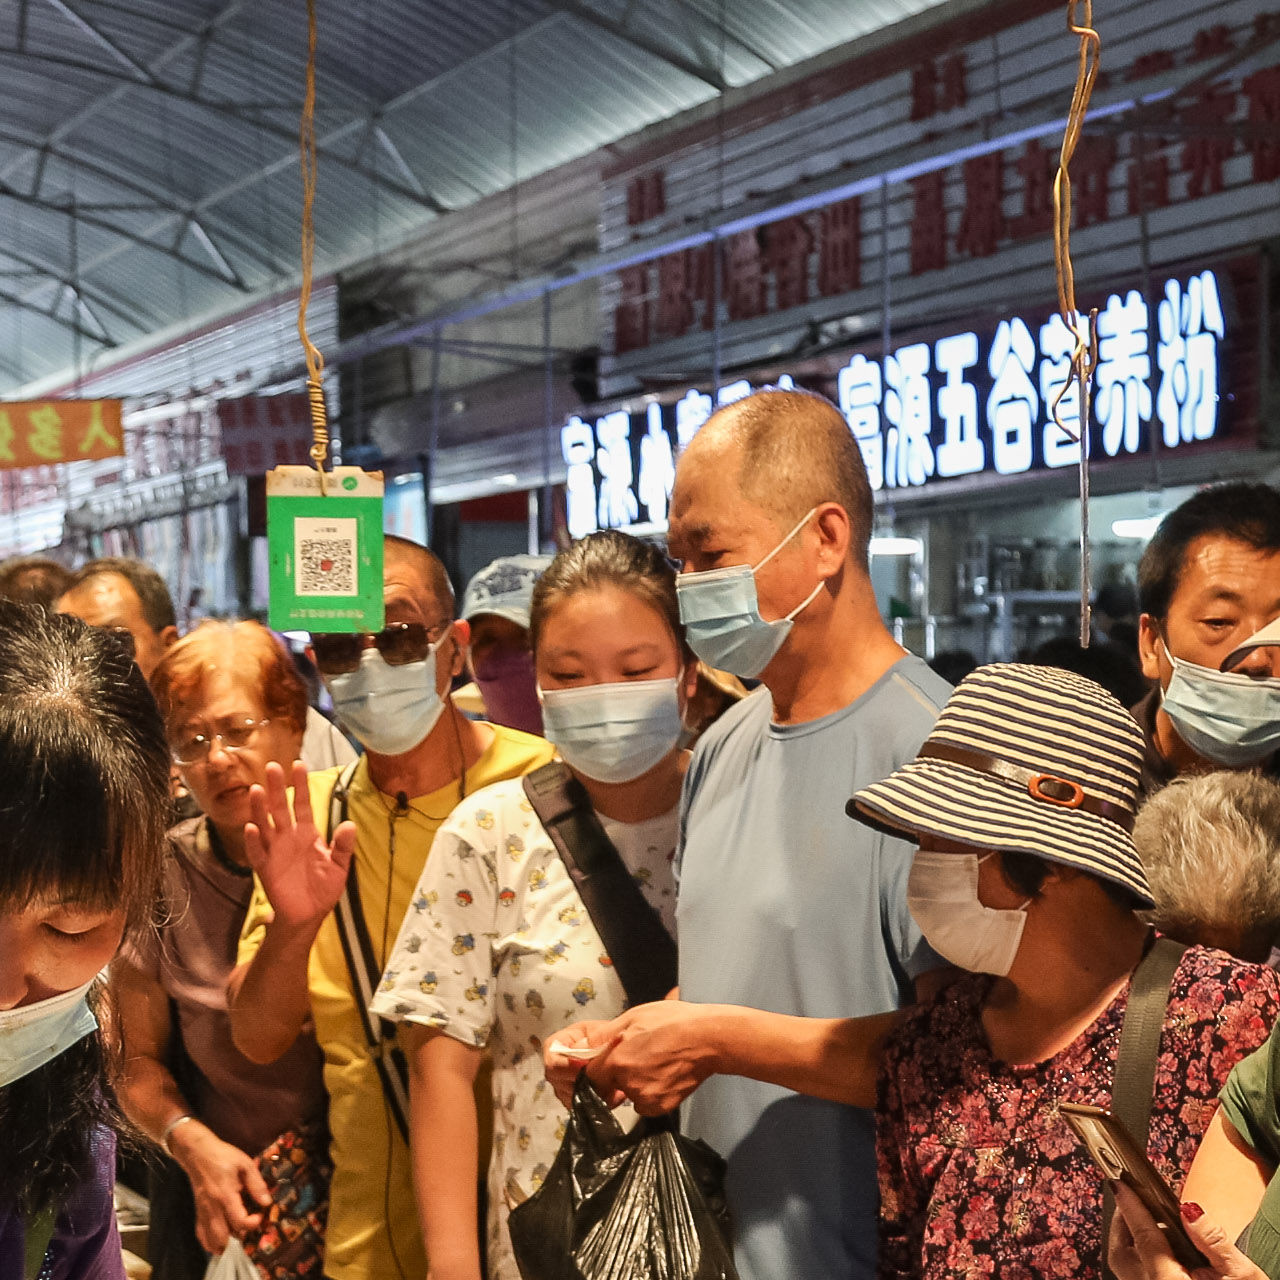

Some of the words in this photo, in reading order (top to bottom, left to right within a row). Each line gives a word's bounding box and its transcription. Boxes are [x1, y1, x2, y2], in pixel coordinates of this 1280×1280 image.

[837, 268, 1226, 491] 富源五谷营养粉
